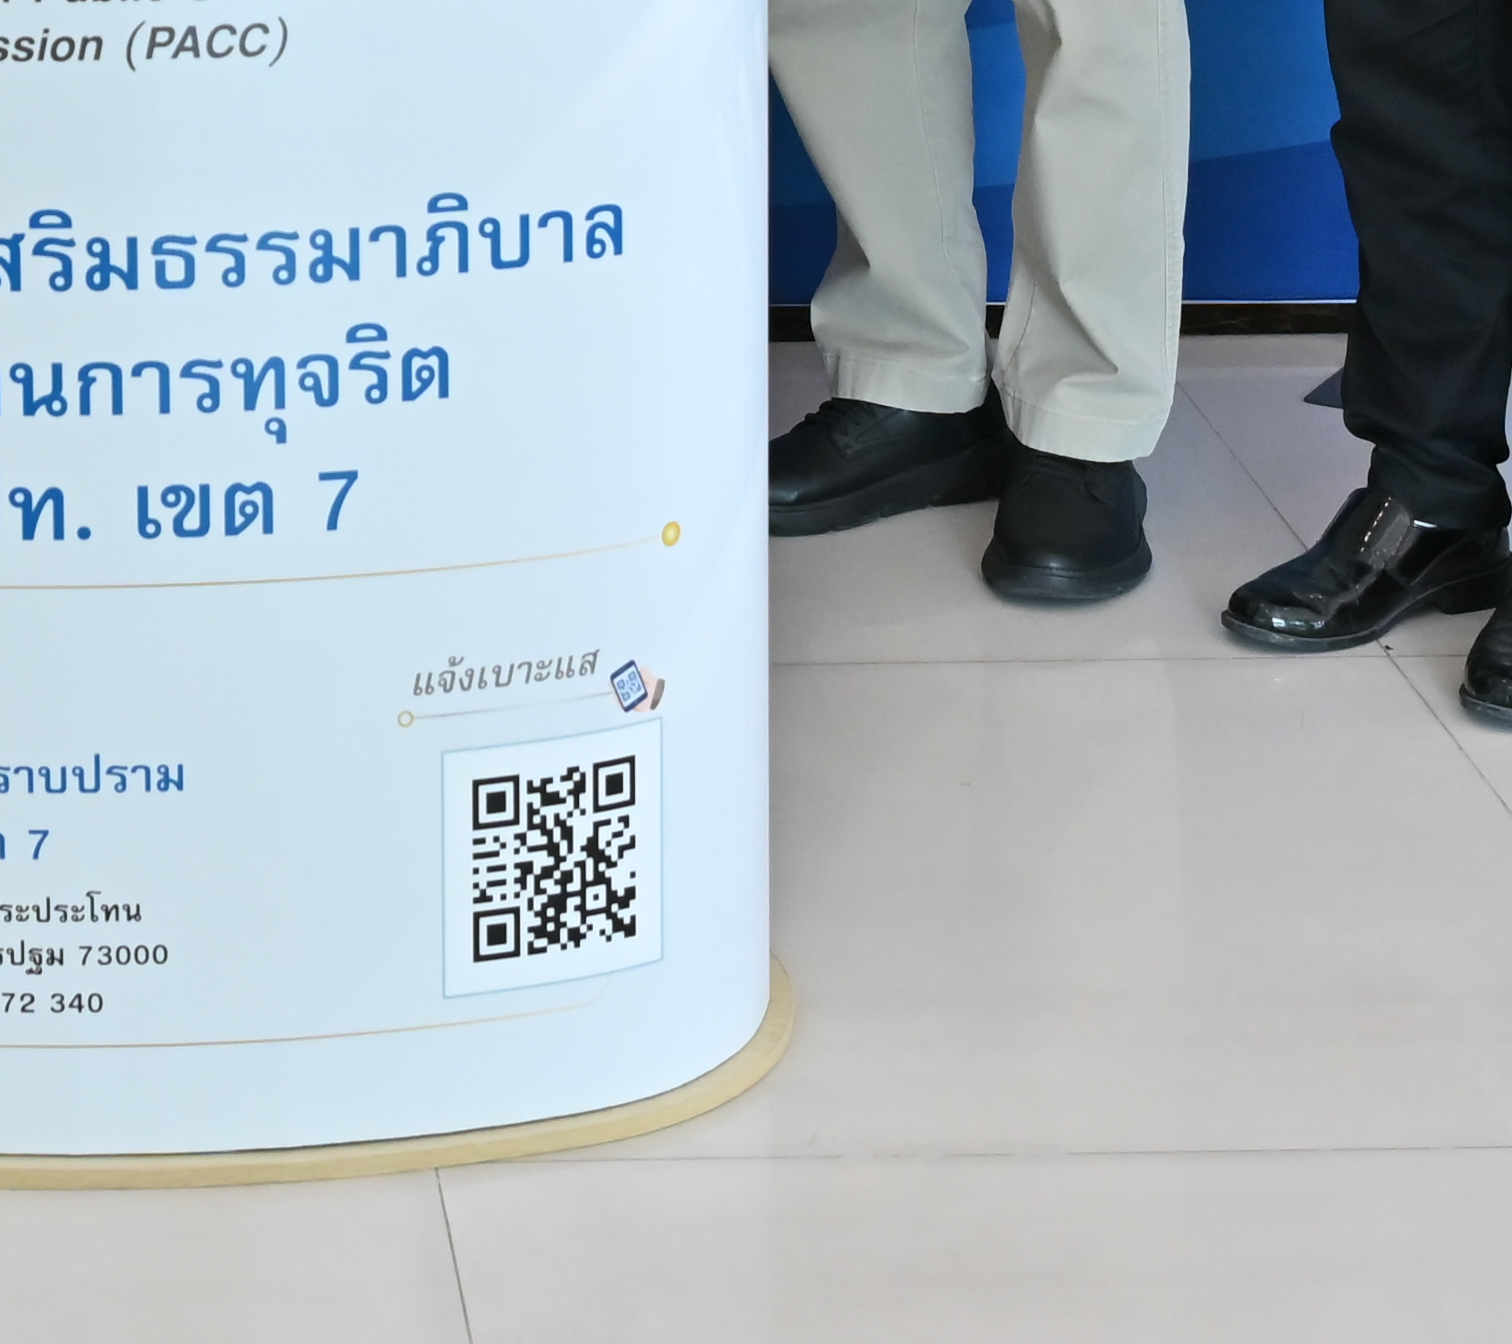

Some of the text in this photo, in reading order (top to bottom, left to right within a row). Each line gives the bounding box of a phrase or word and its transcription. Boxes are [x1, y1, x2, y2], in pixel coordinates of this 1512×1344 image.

[125, 16, 288, 72] (PACC)
[136, 480, 274, 540] เขต
[317, 469, 359, 532] 7
[412, 648, 601, 697] แจ้งเบาะแส
[27, 828, 50, 861] 7
[78, 944, 169, 966] 73000
[49, 992, 105, 1014] 340
